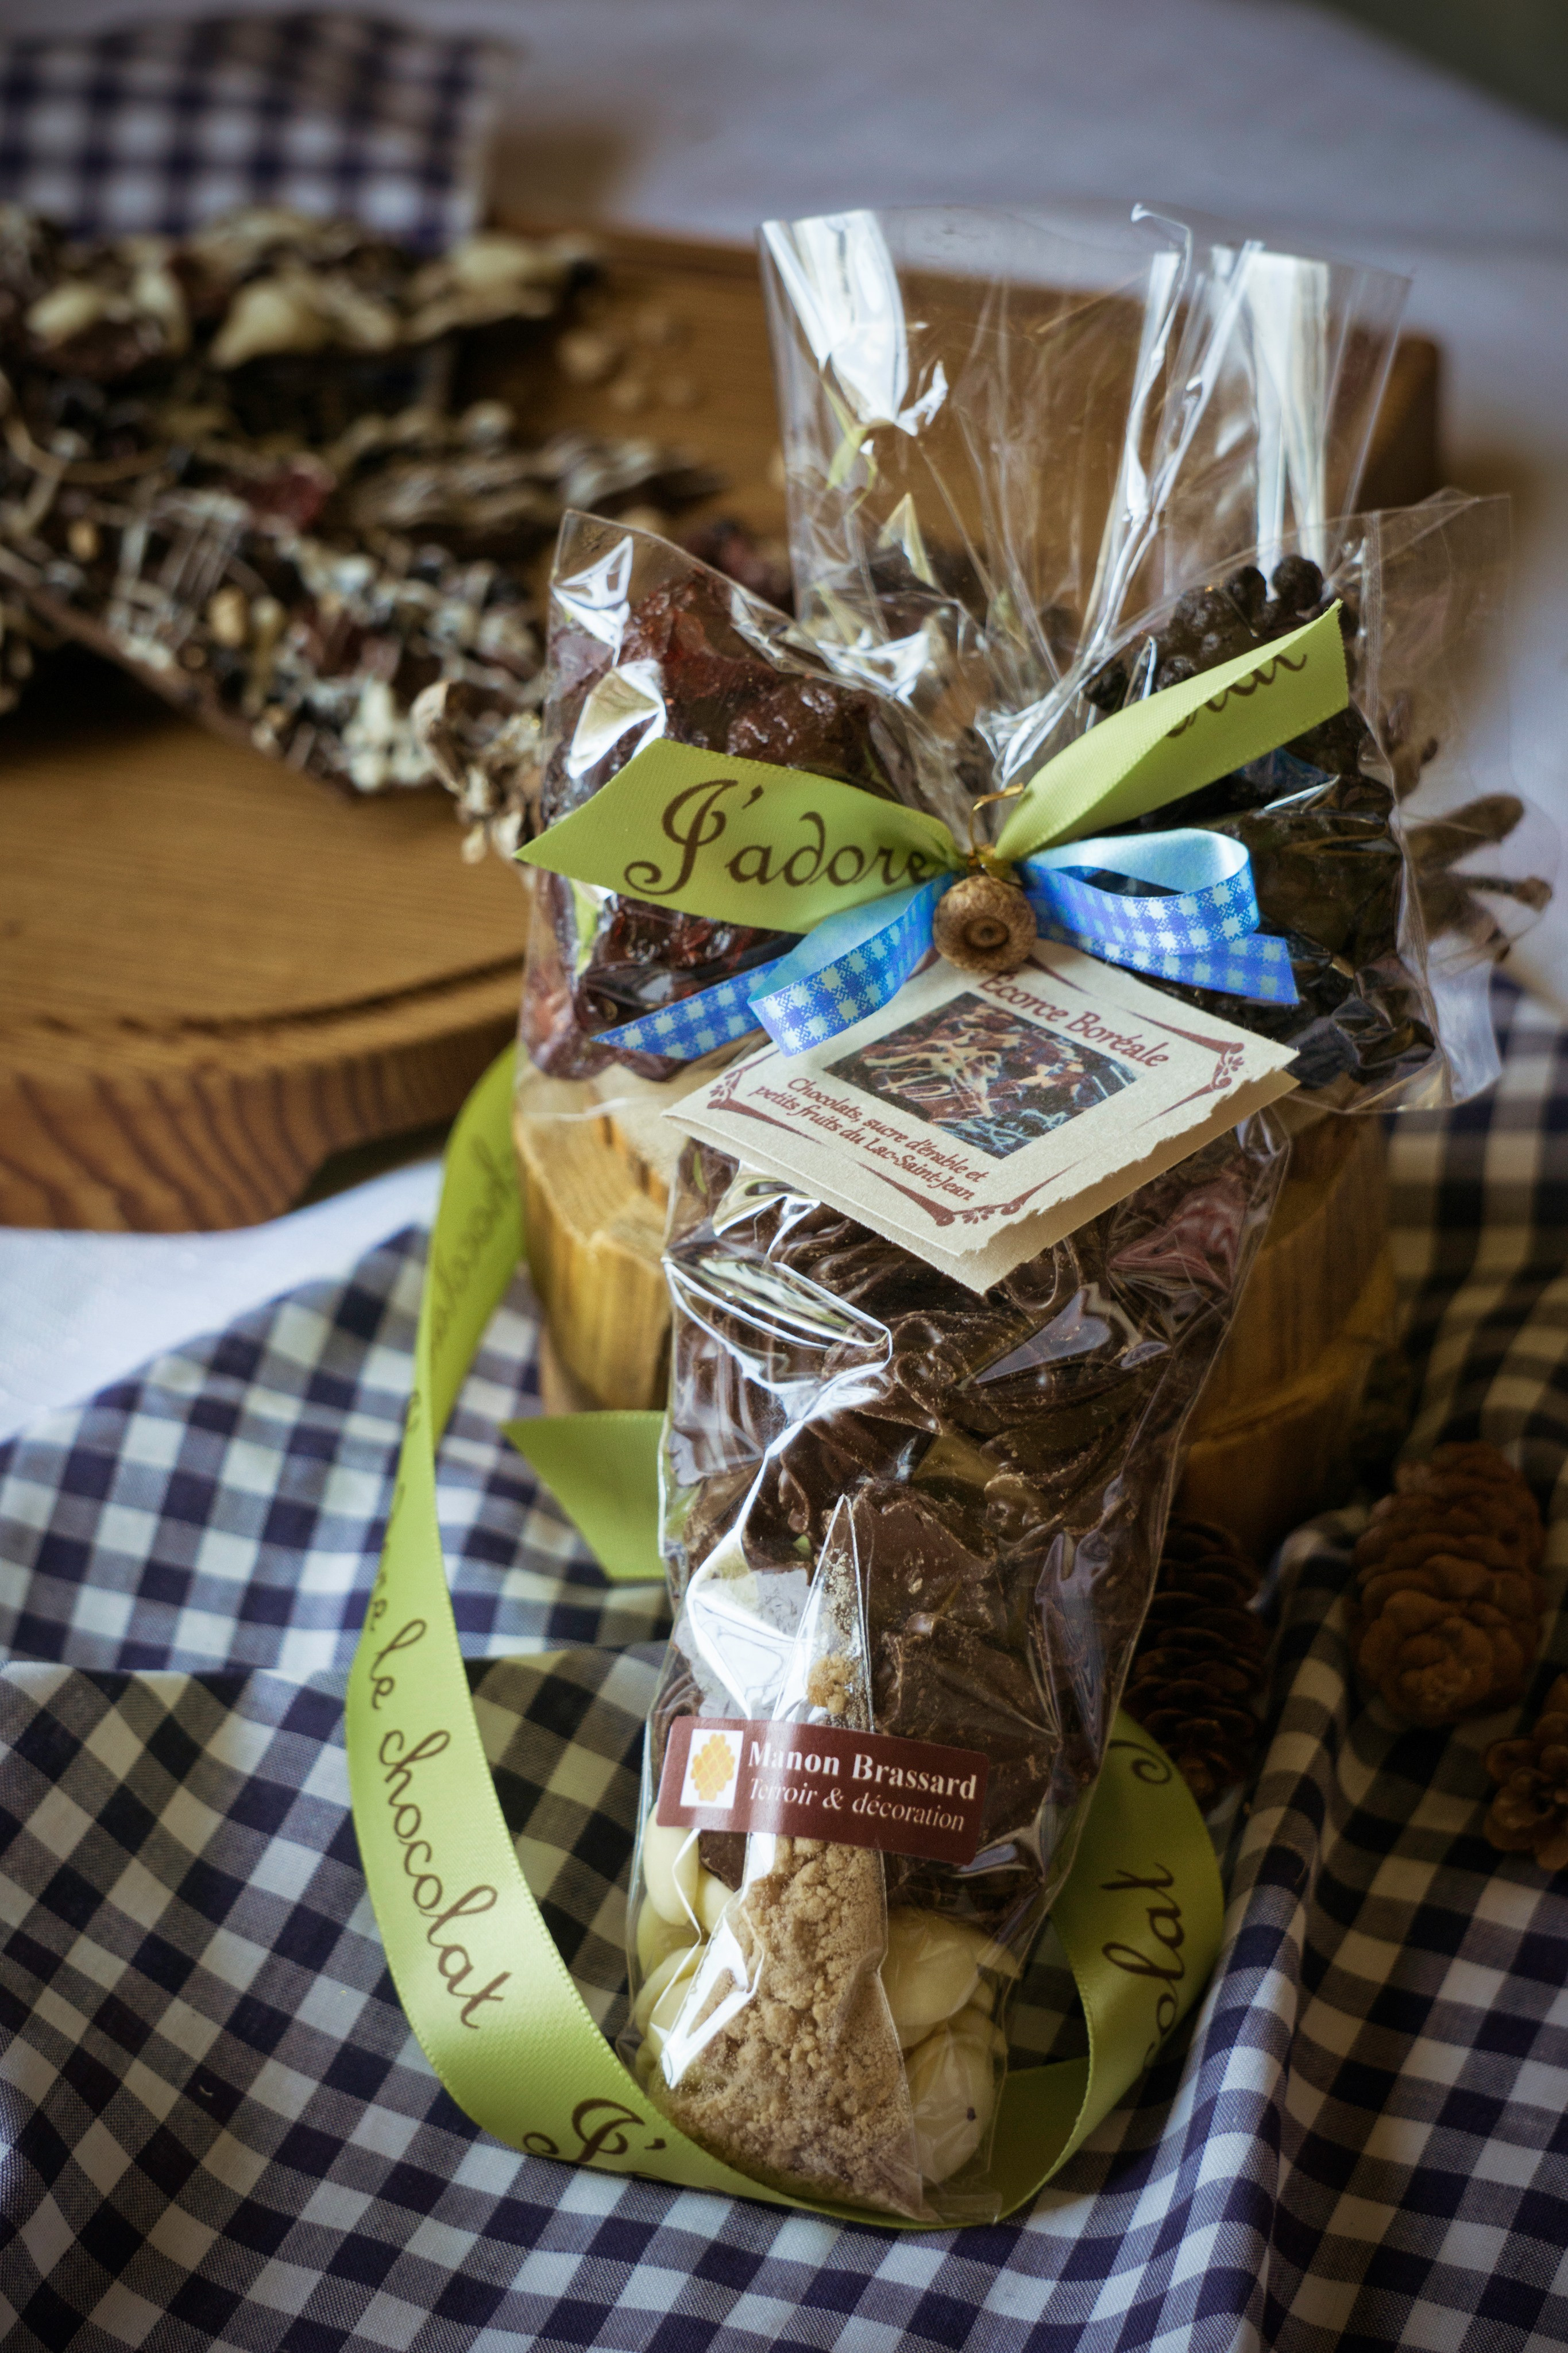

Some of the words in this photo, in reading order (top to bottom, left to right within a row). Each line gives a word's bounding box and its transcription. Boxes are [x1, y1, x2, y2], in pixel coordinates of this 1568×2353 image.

[624, 778, 932, 895] J'adore
[1065, 1011, 1169, 1067] Boréale
[747, 1086, 801, 1110] petits
[786, 1104, 843, 1132] fruits
[839, 1127, 867, 1144] du
[863, 1137, 975, 1201] Lac-Saint-Jean
[787, 1078, 863, 1123] Chocolats,
[863, 1118, 909, 1143] sucre
[904, 1139, 969, 1174] d'érable
[965, 1171, 990, 1182] et
[369, 1619, 427, 1710] le
[748, 1741, 840, 1776] Manon
[852, 1753, 977, 1800] Brassard
[750, 1778, 818, 1806] Terroir
[822, 1787, 844, 1810] &
[852, 1792, 965, 1831] décoration
[378, 1729, 512, 2030] chocolat
